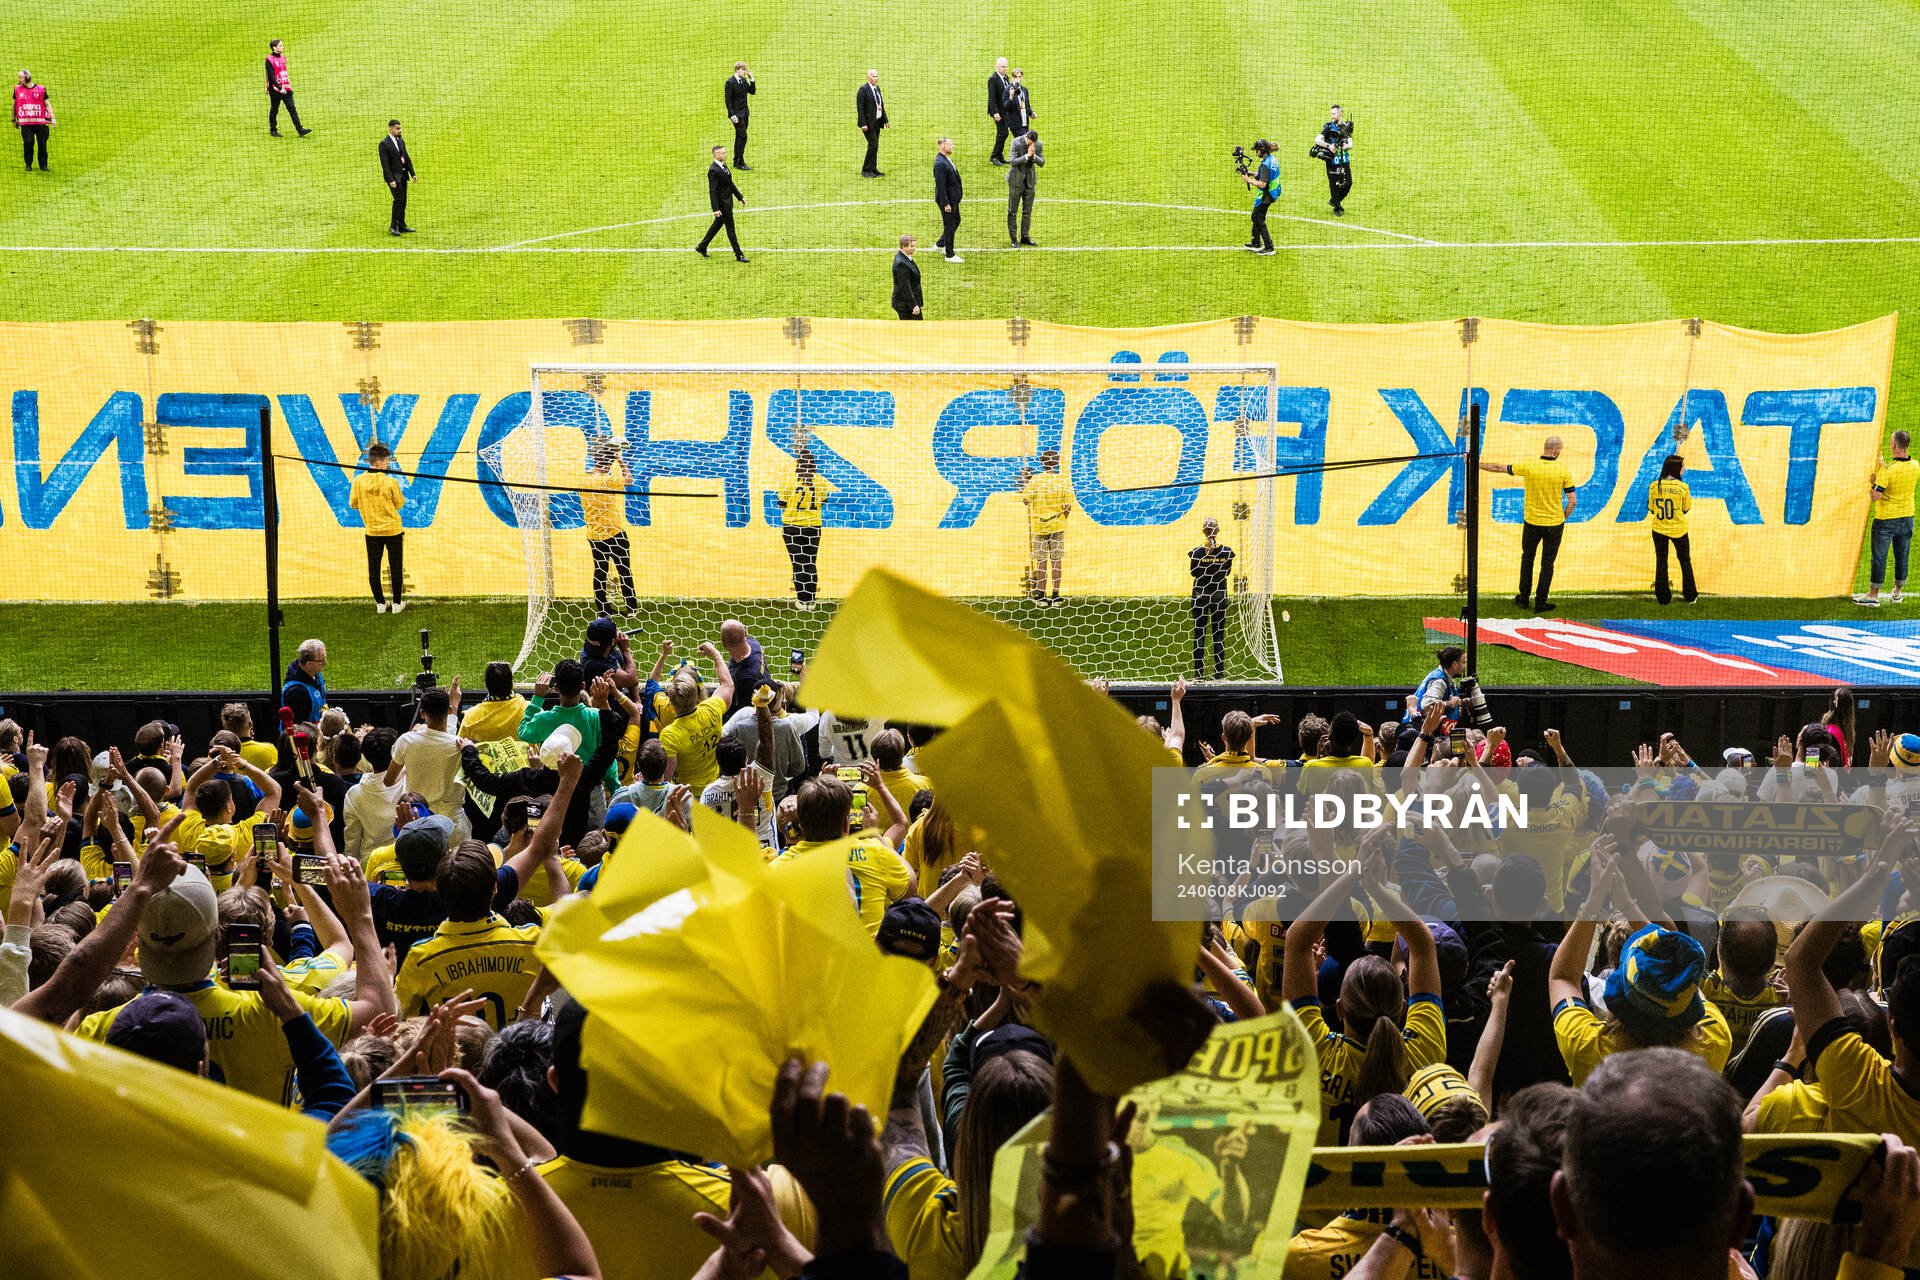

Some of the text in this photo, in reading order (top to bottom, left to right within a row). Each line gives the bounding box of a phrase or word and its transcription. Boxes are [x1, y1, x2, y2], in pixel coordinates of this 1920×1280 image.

[795, 486, 817, 510] 21
[1655, 498, 1674, 520] 50
[842, 734, 869, 760] 11
[704, 790, 736, 805] IBRAHIM
